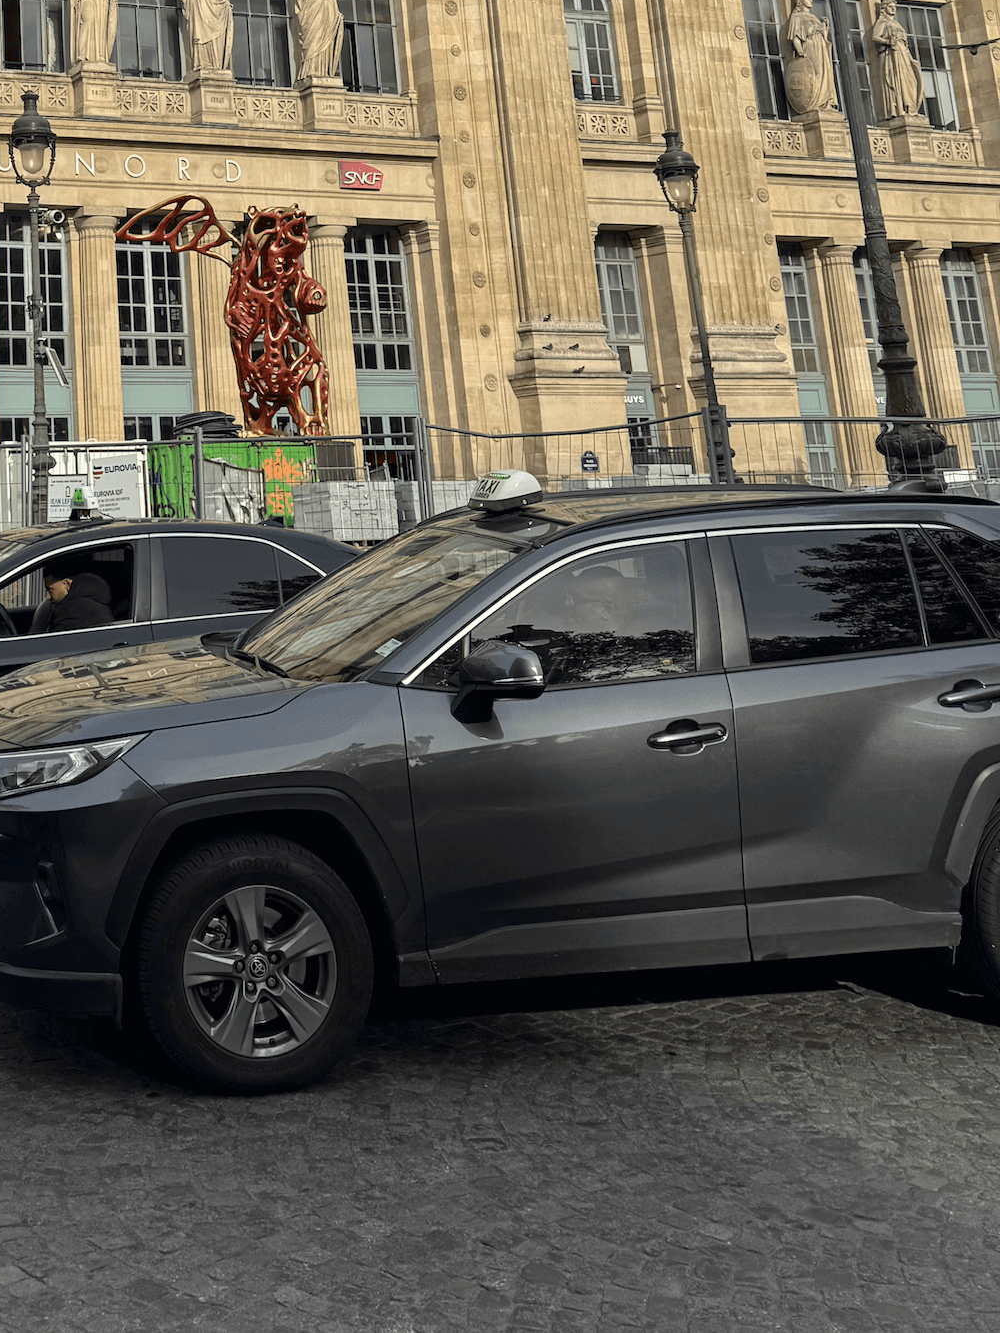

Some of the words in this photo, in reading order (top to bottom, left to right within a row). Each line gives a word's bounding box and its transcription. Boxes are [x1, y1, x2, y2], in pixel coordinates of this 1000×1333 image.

[75, 151, 241, 182] NORD
[343, 171, 382, 185] SNCF
[104, 463, 137, 473] EUROVIA
[476, 479, 500, 494] TAXI
